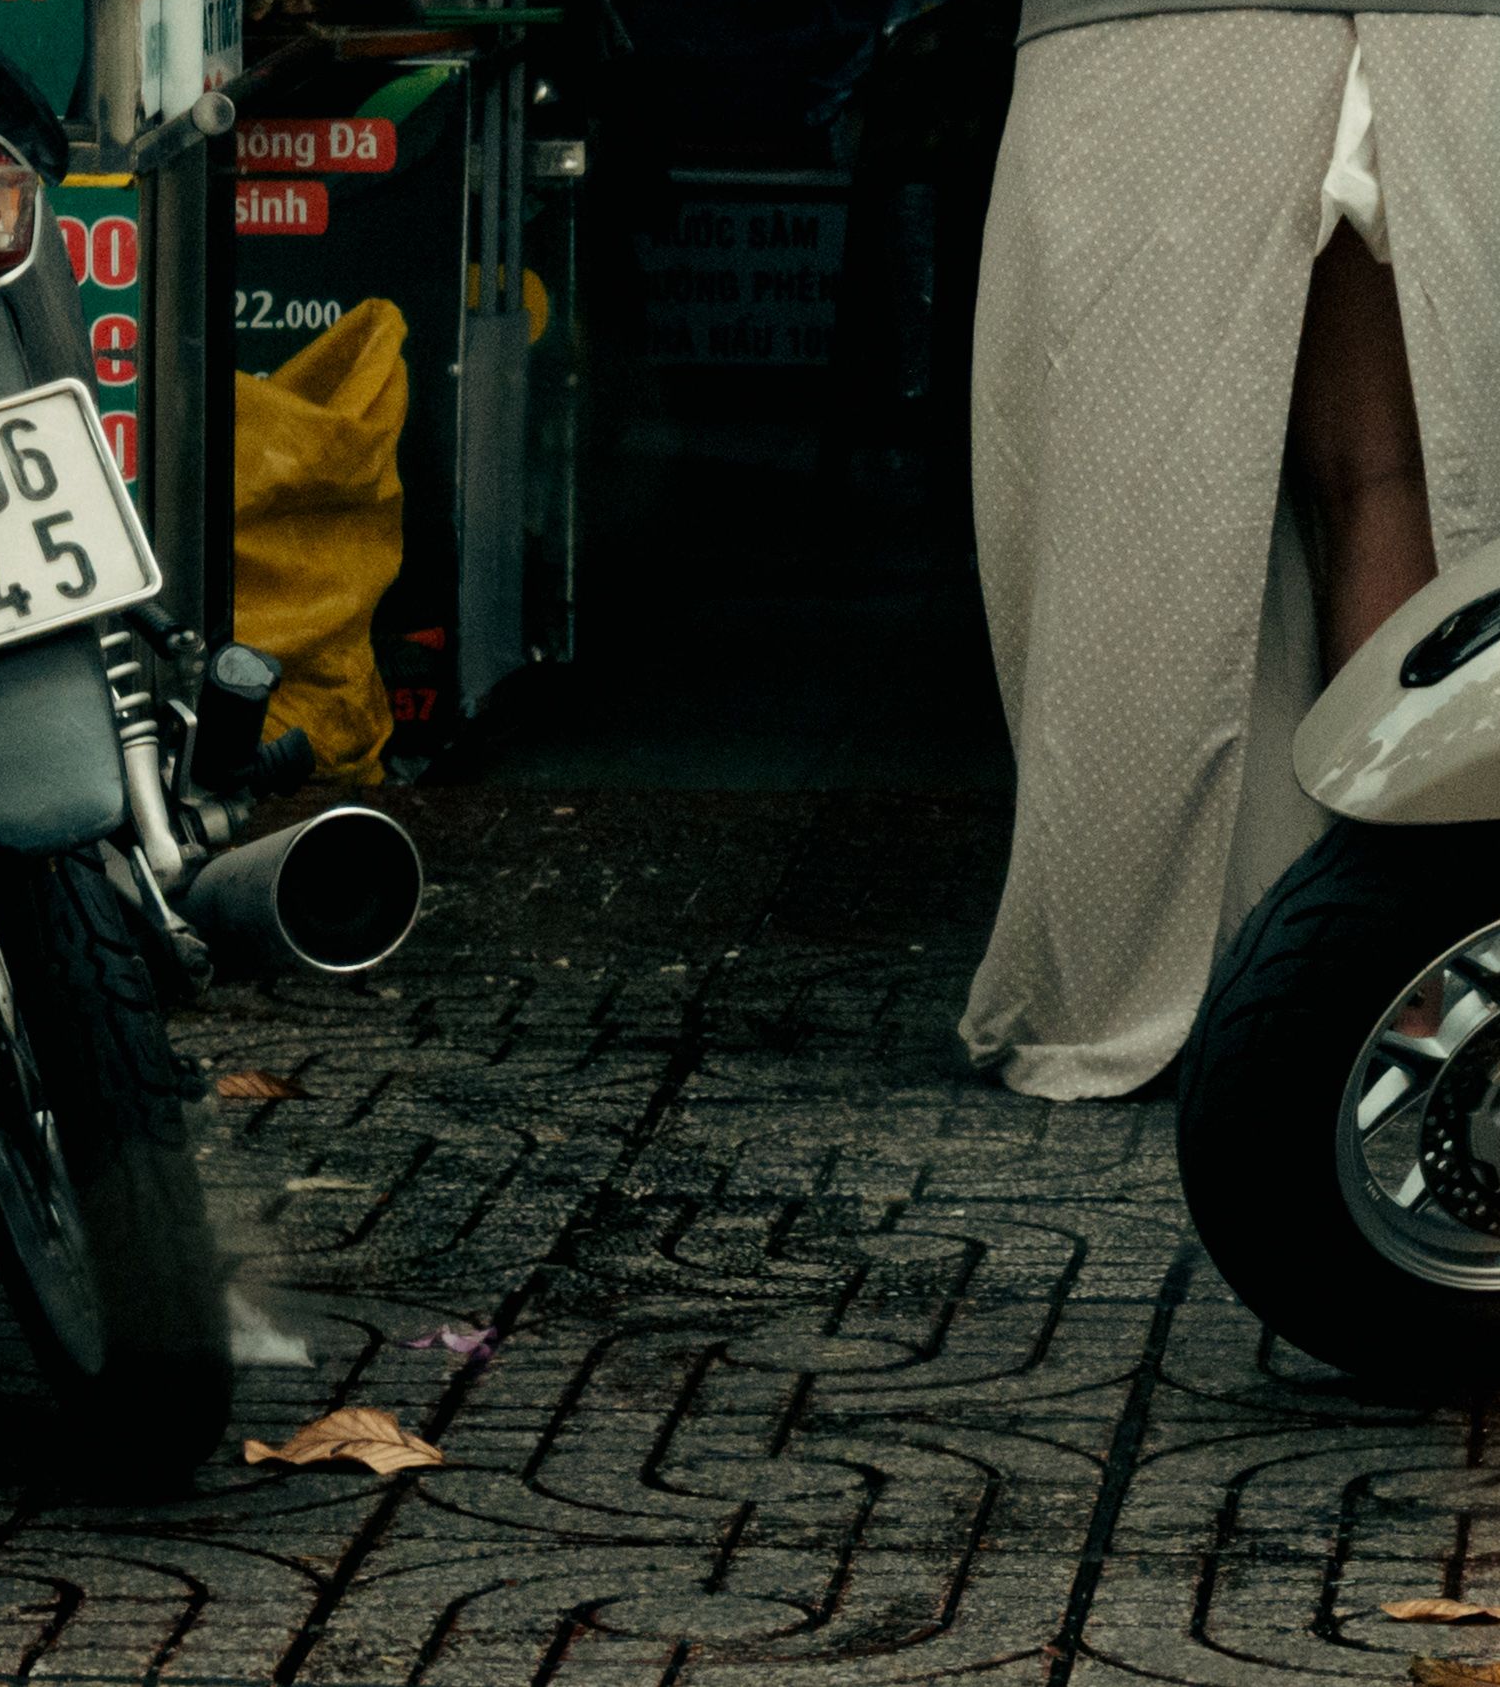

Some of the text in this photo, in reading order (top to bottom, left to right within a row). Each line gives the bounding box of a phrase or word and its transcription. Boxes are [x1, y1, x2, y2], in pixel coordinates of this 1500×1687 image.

[328, 121, 379, 160] Đá
[235, 187, 308, 225] sinh
[235, 288, 343, 330] 22.000
